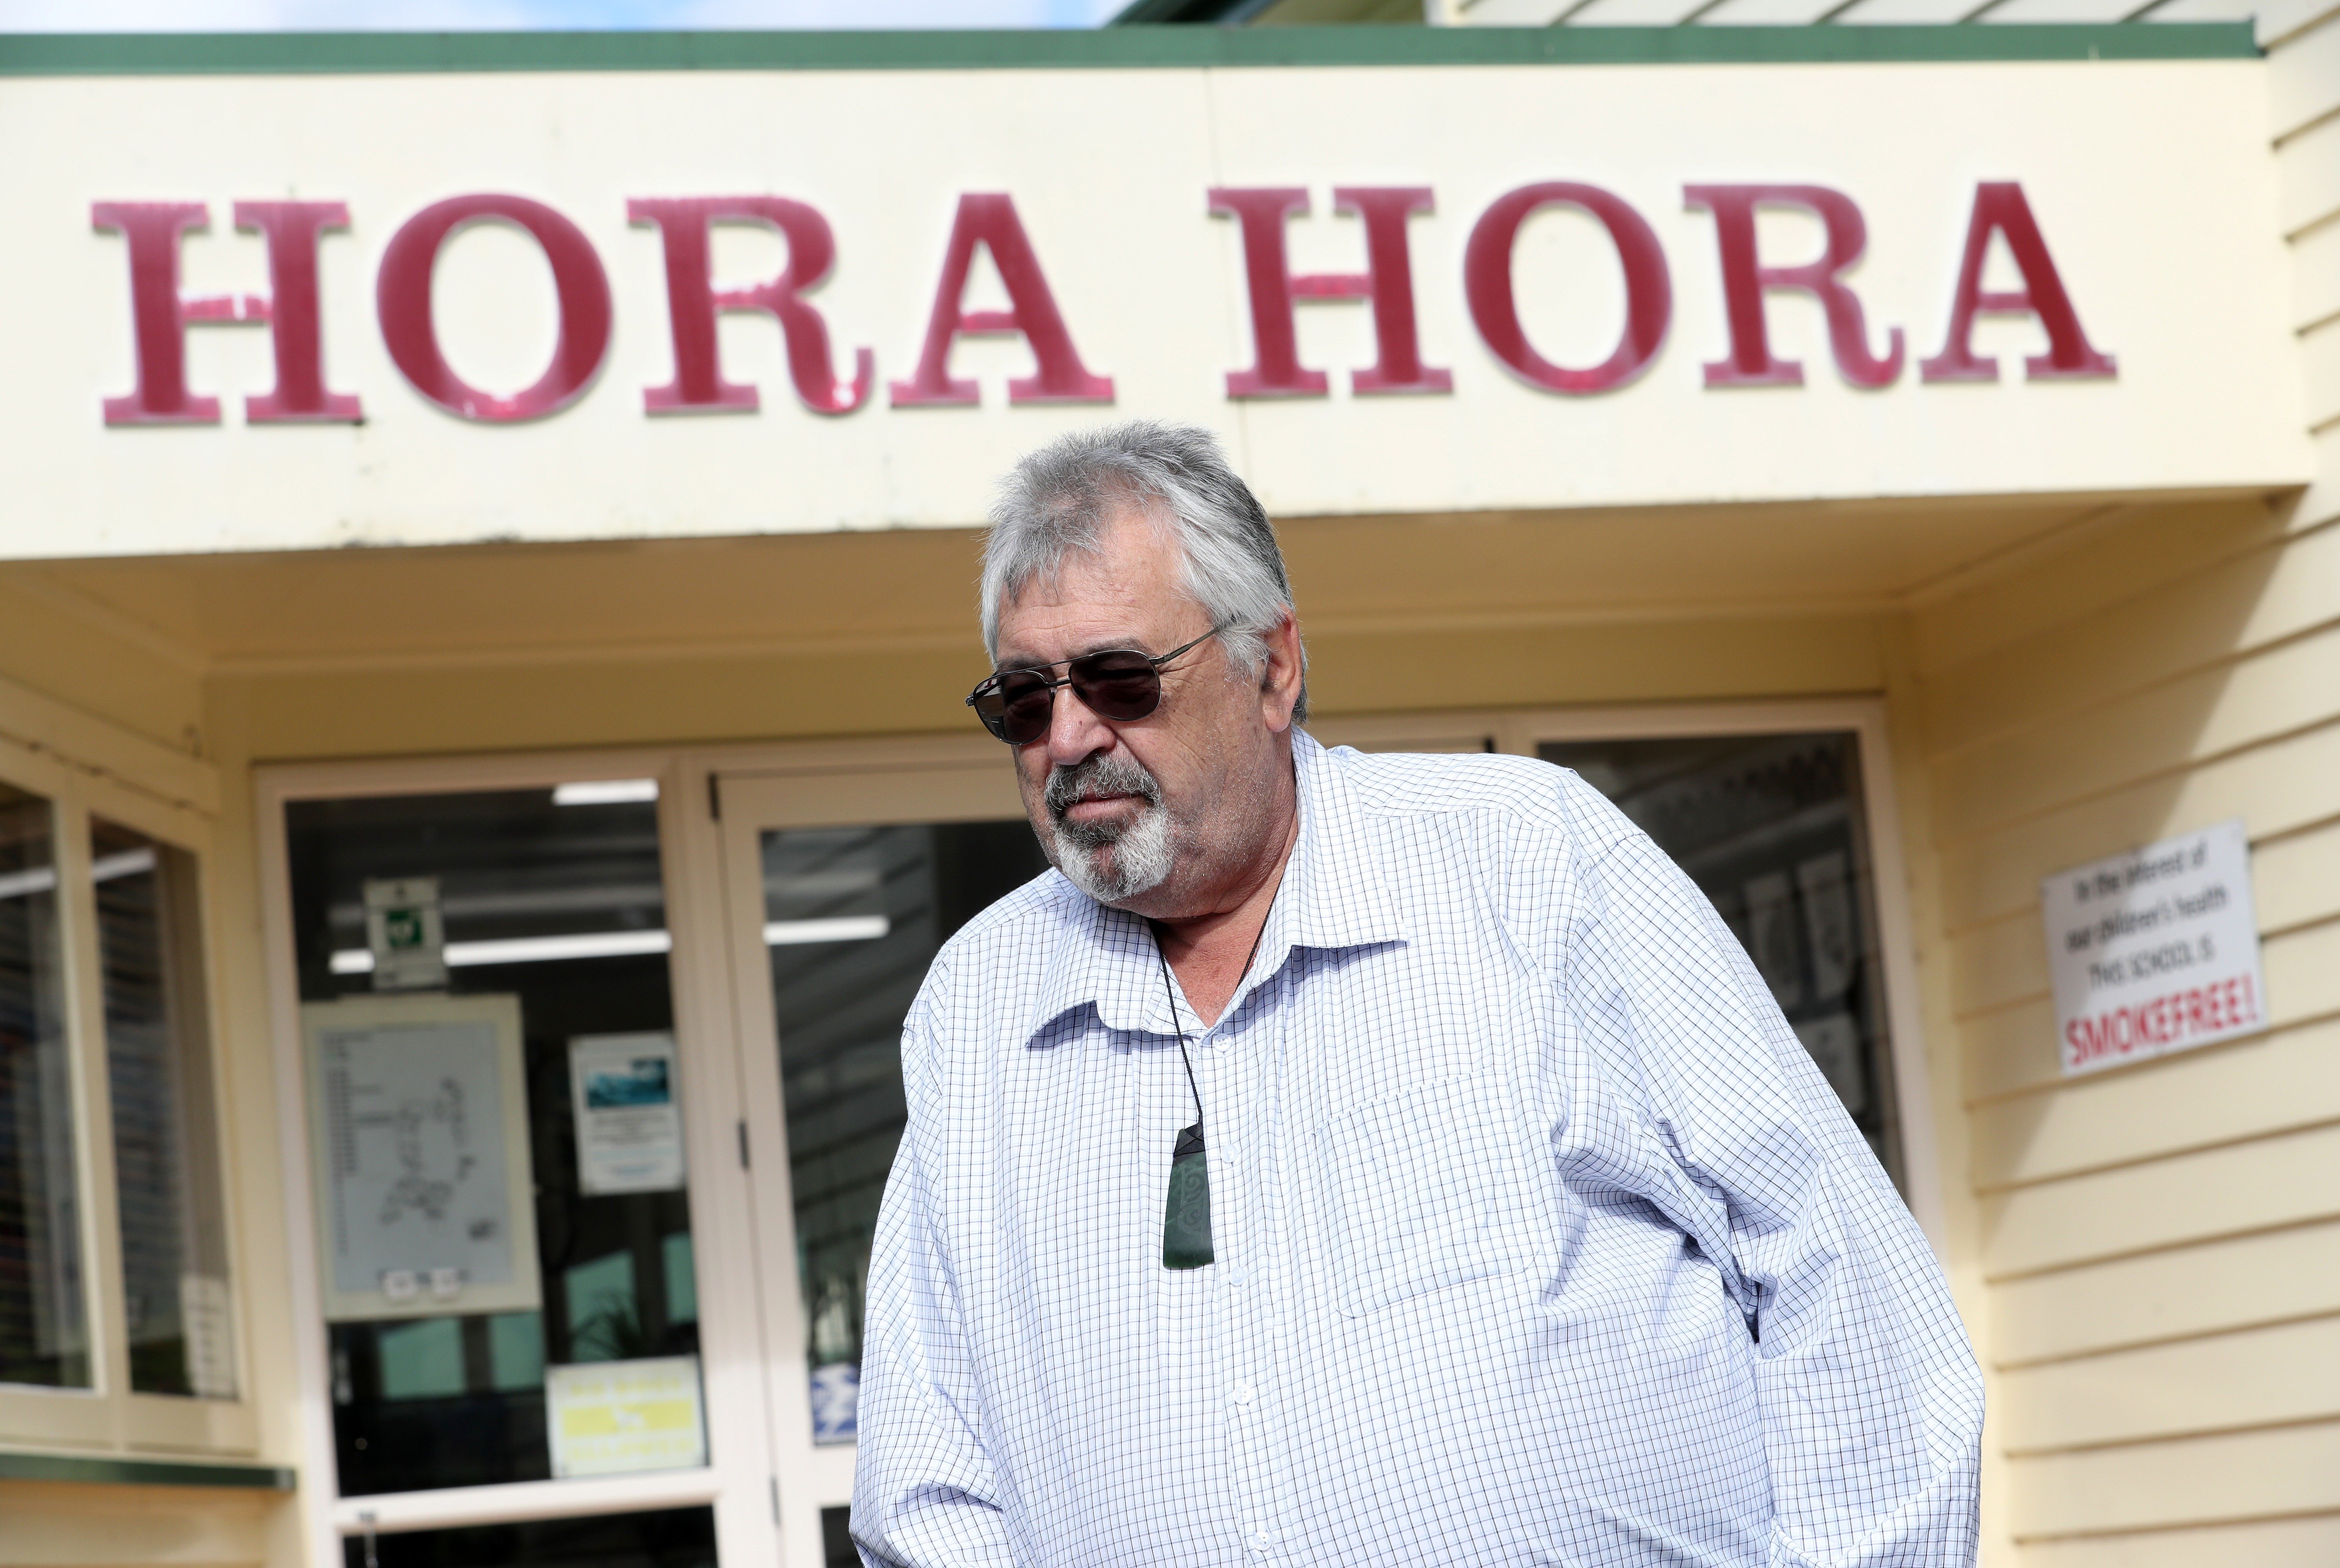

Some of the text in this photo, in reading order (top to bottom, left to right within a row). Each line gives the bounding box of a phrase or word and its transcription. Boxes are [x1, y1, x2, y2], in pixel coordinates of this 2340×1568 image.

[91, 181, 2119, 423] HORA HORA
[2096, 872, 2119, 896] the
[2127, 851, 2185, 884] interest
[2192, 841, 2208, 866] of
[2175, 885, 2229, 916] health
[2066, 972, 2258, 1066] SMOKEFREE!
